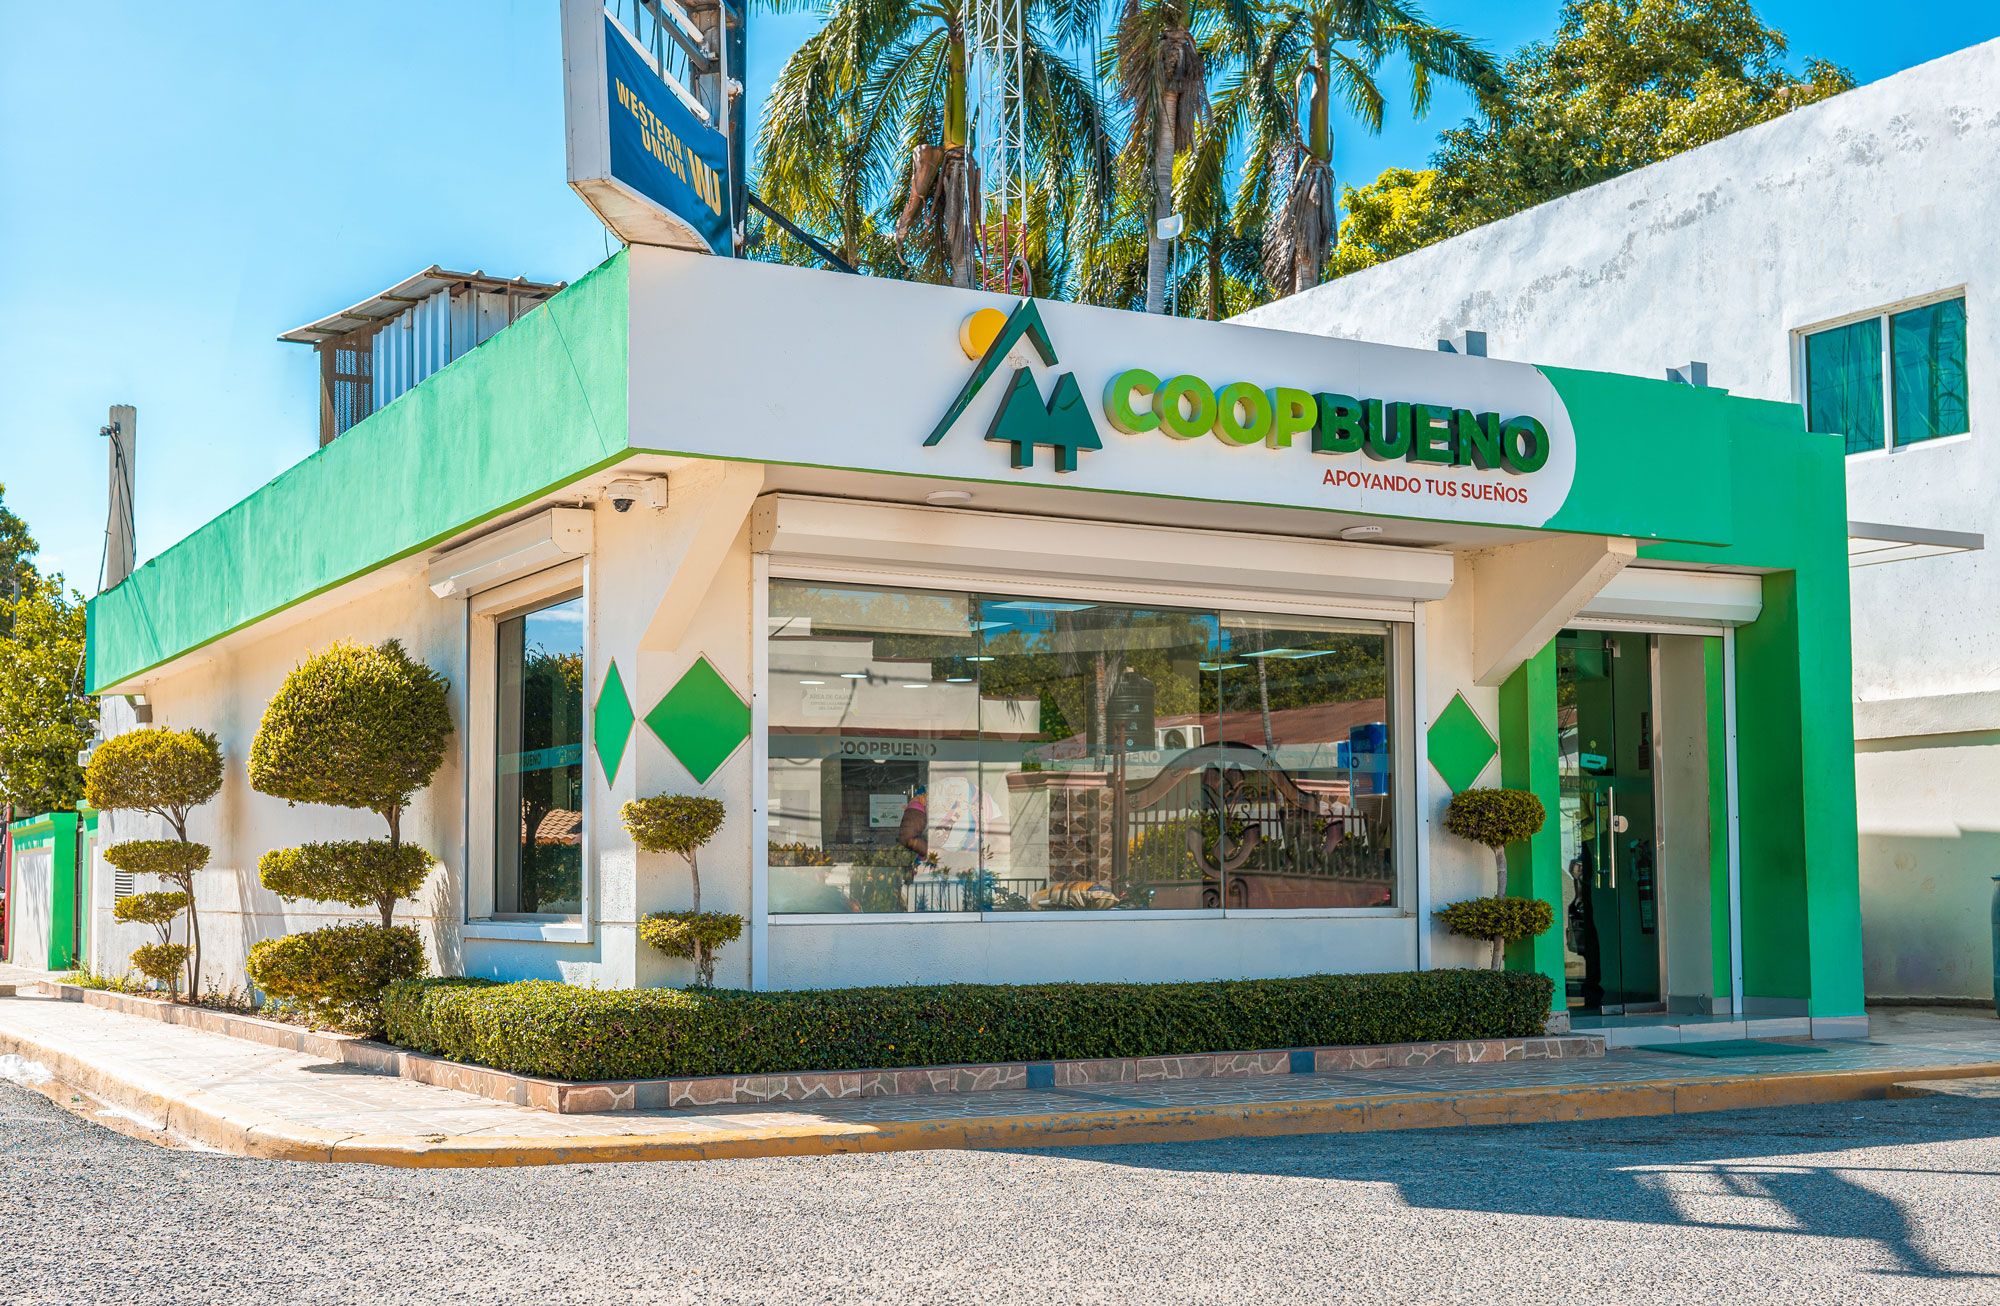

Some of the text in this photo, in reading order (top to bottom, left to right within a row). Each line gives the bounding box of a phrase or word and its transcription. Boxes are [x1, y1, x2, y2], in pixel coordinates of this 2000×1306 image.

[615, 77, 683, 160] WESTERN
[641, 125, 687, 184] UNION
[1103, 368, 1550, 476] COOPBUENO
[1322, 468, 1528, 504] APOYANDO TUS SUEÑOS
